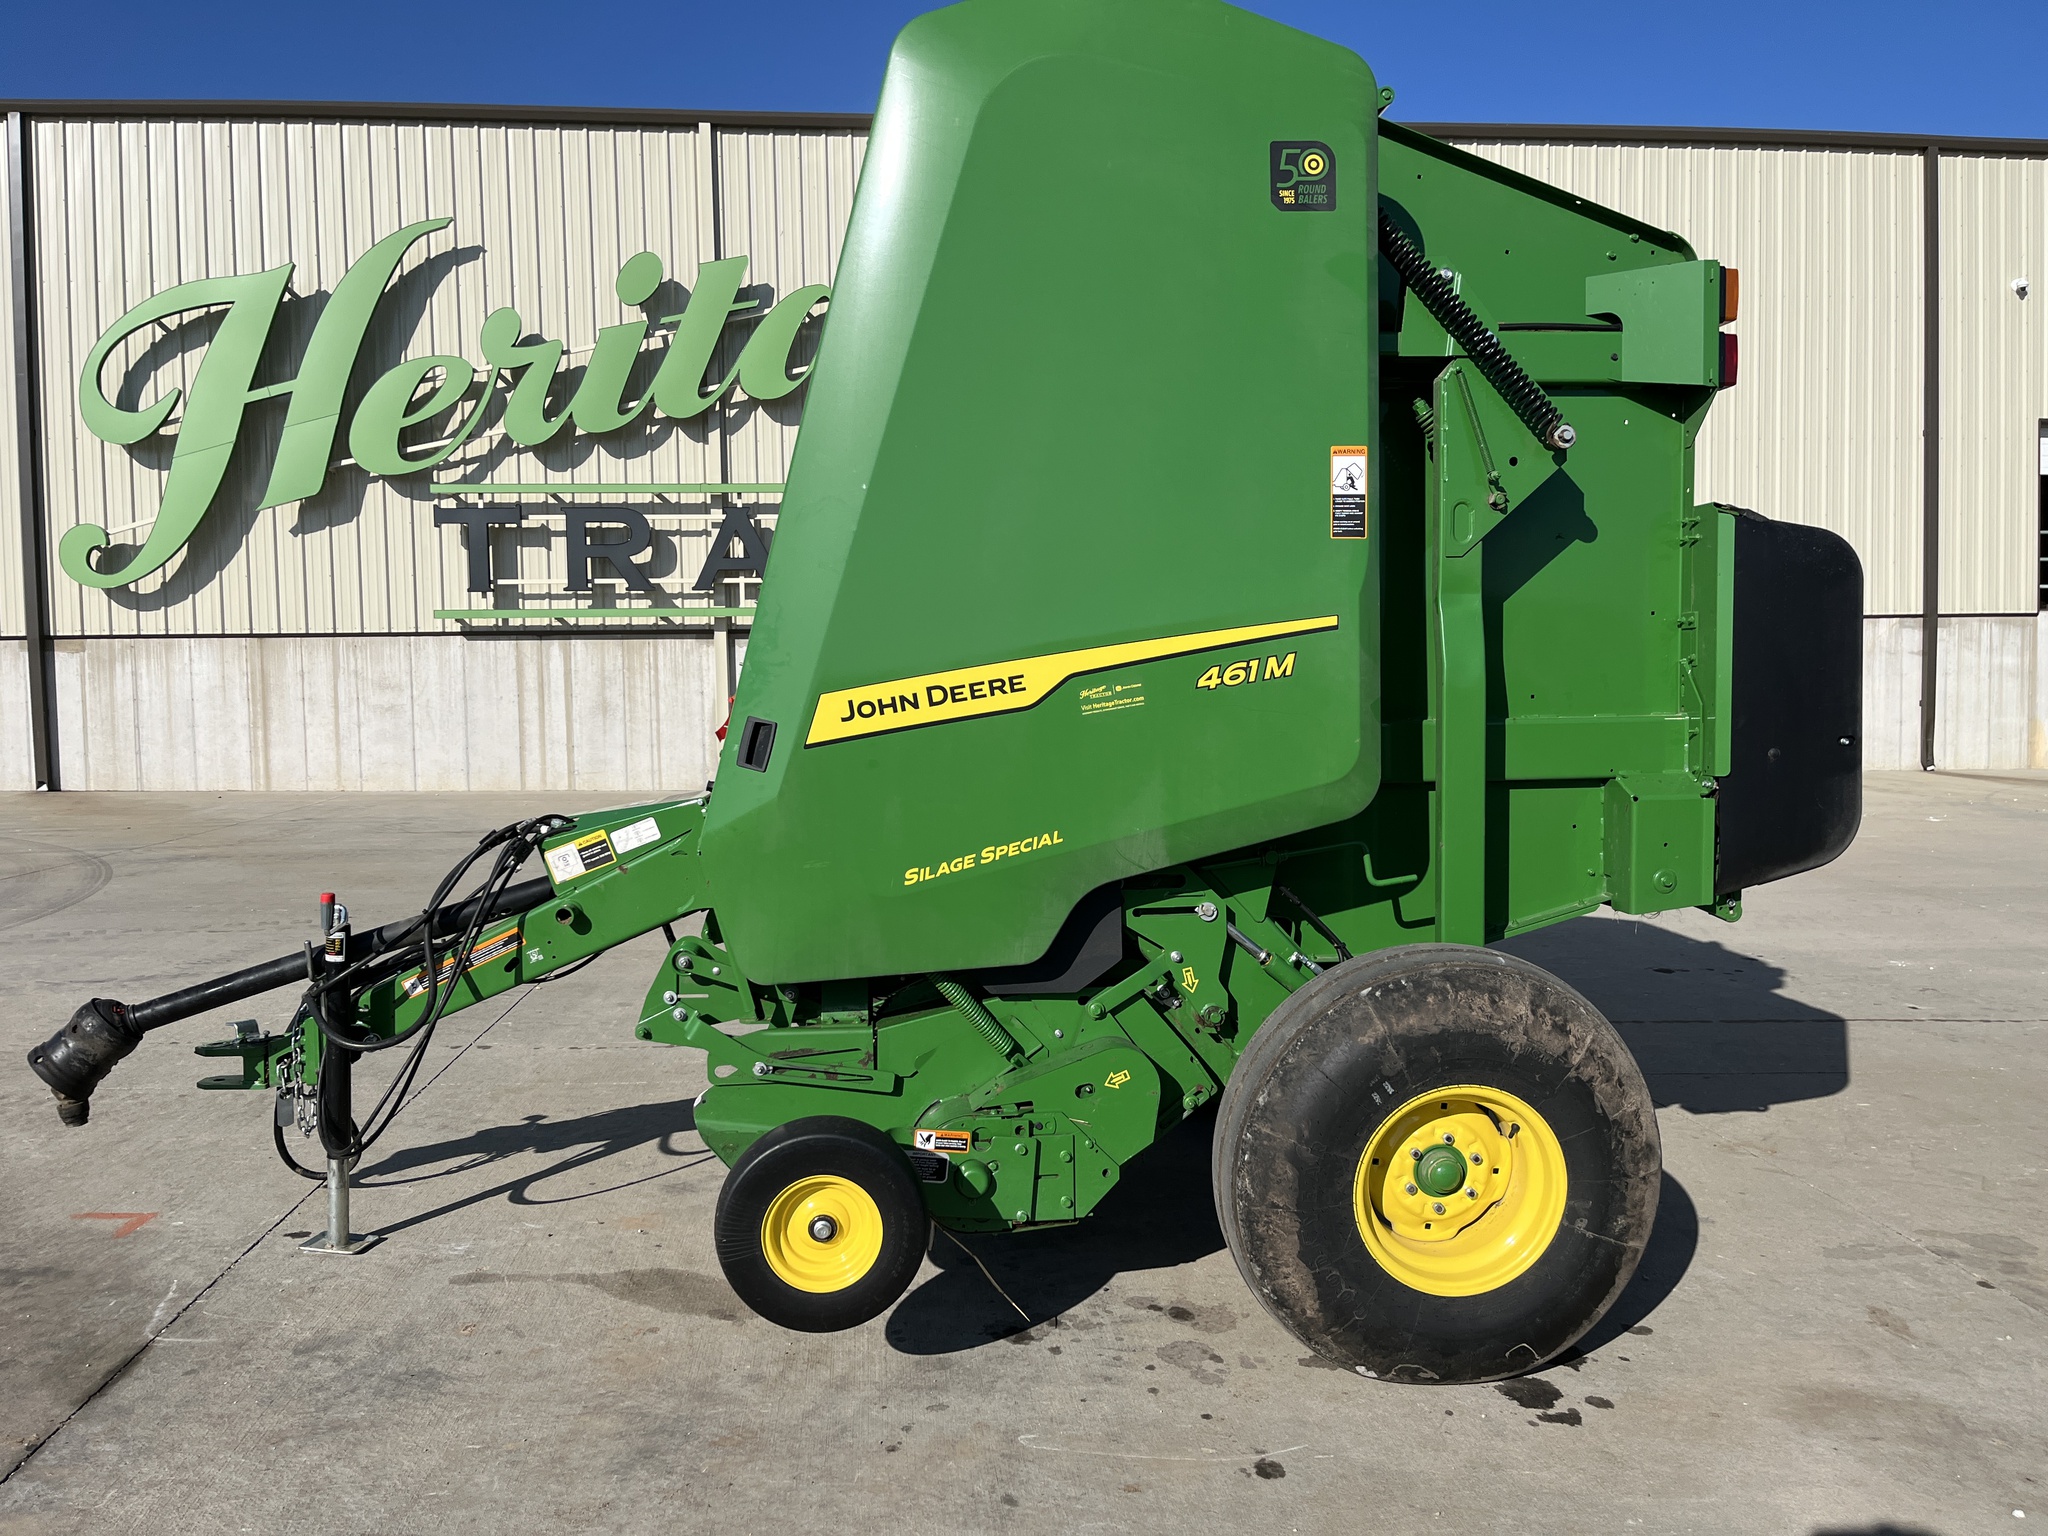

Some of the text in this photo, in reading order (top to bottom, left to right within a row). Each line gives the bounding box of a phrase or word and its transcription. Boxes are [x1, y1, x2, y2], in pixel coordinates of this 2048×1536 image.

[1279, 189, 1295, 197] SINCE
[1298, 184, 1327, 194] ROUND
[1298, 194, 1328, 204] BALERS
[841, 674, 1027, 722] JOHN DEERE
[1080, 703, 1092, 711] Visit
[1092, 695, 1145, 709] HeritageTractor.com
[582, 834, 602, 844] CAUTION
[904, 830, 1064, 886] SILAGE SPECIAL
